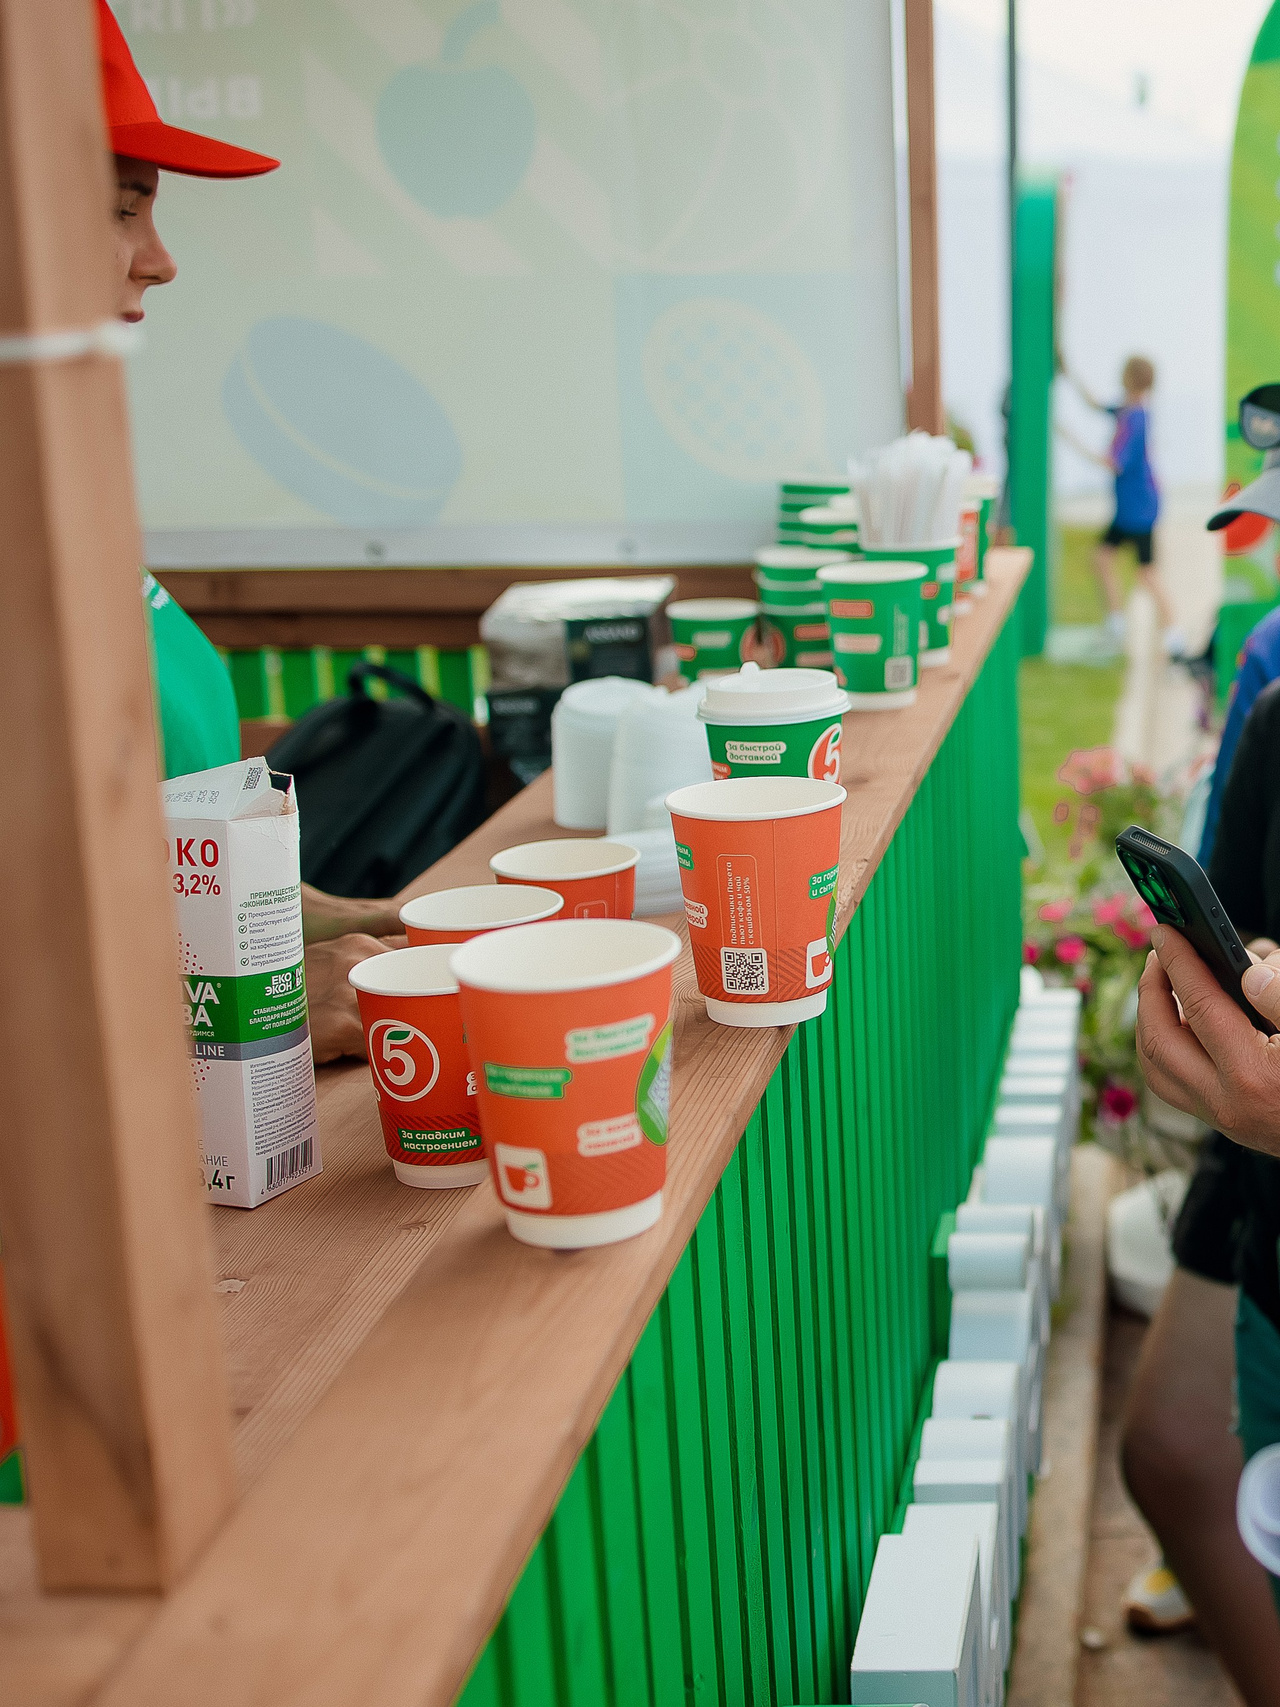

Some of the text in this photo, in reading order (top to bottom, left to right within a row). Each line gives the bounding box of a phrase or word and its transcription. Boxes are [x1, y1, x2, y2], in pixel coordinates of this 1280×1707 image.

[728, 743, 782, 753] За быстрой
[729, 753, 778, 761] доставкой
[172, 872, 221, 898] 3,2%
[734, 876, 742, 895] чай
[812, 875, 822, 885] За
[812, 889, 818, 897] и
[728, 893, 738, 945] Подписчики
[736, 904, 745, 923] кофе
[746, 896, 754, 940] кешбэком
[195, 1044, 225, 1057] LINE
[382, 1026, 417, 1087] 5
[402, 1130, 466, 1141] За сладким
[403, 1138, 478, 1152] настроением
